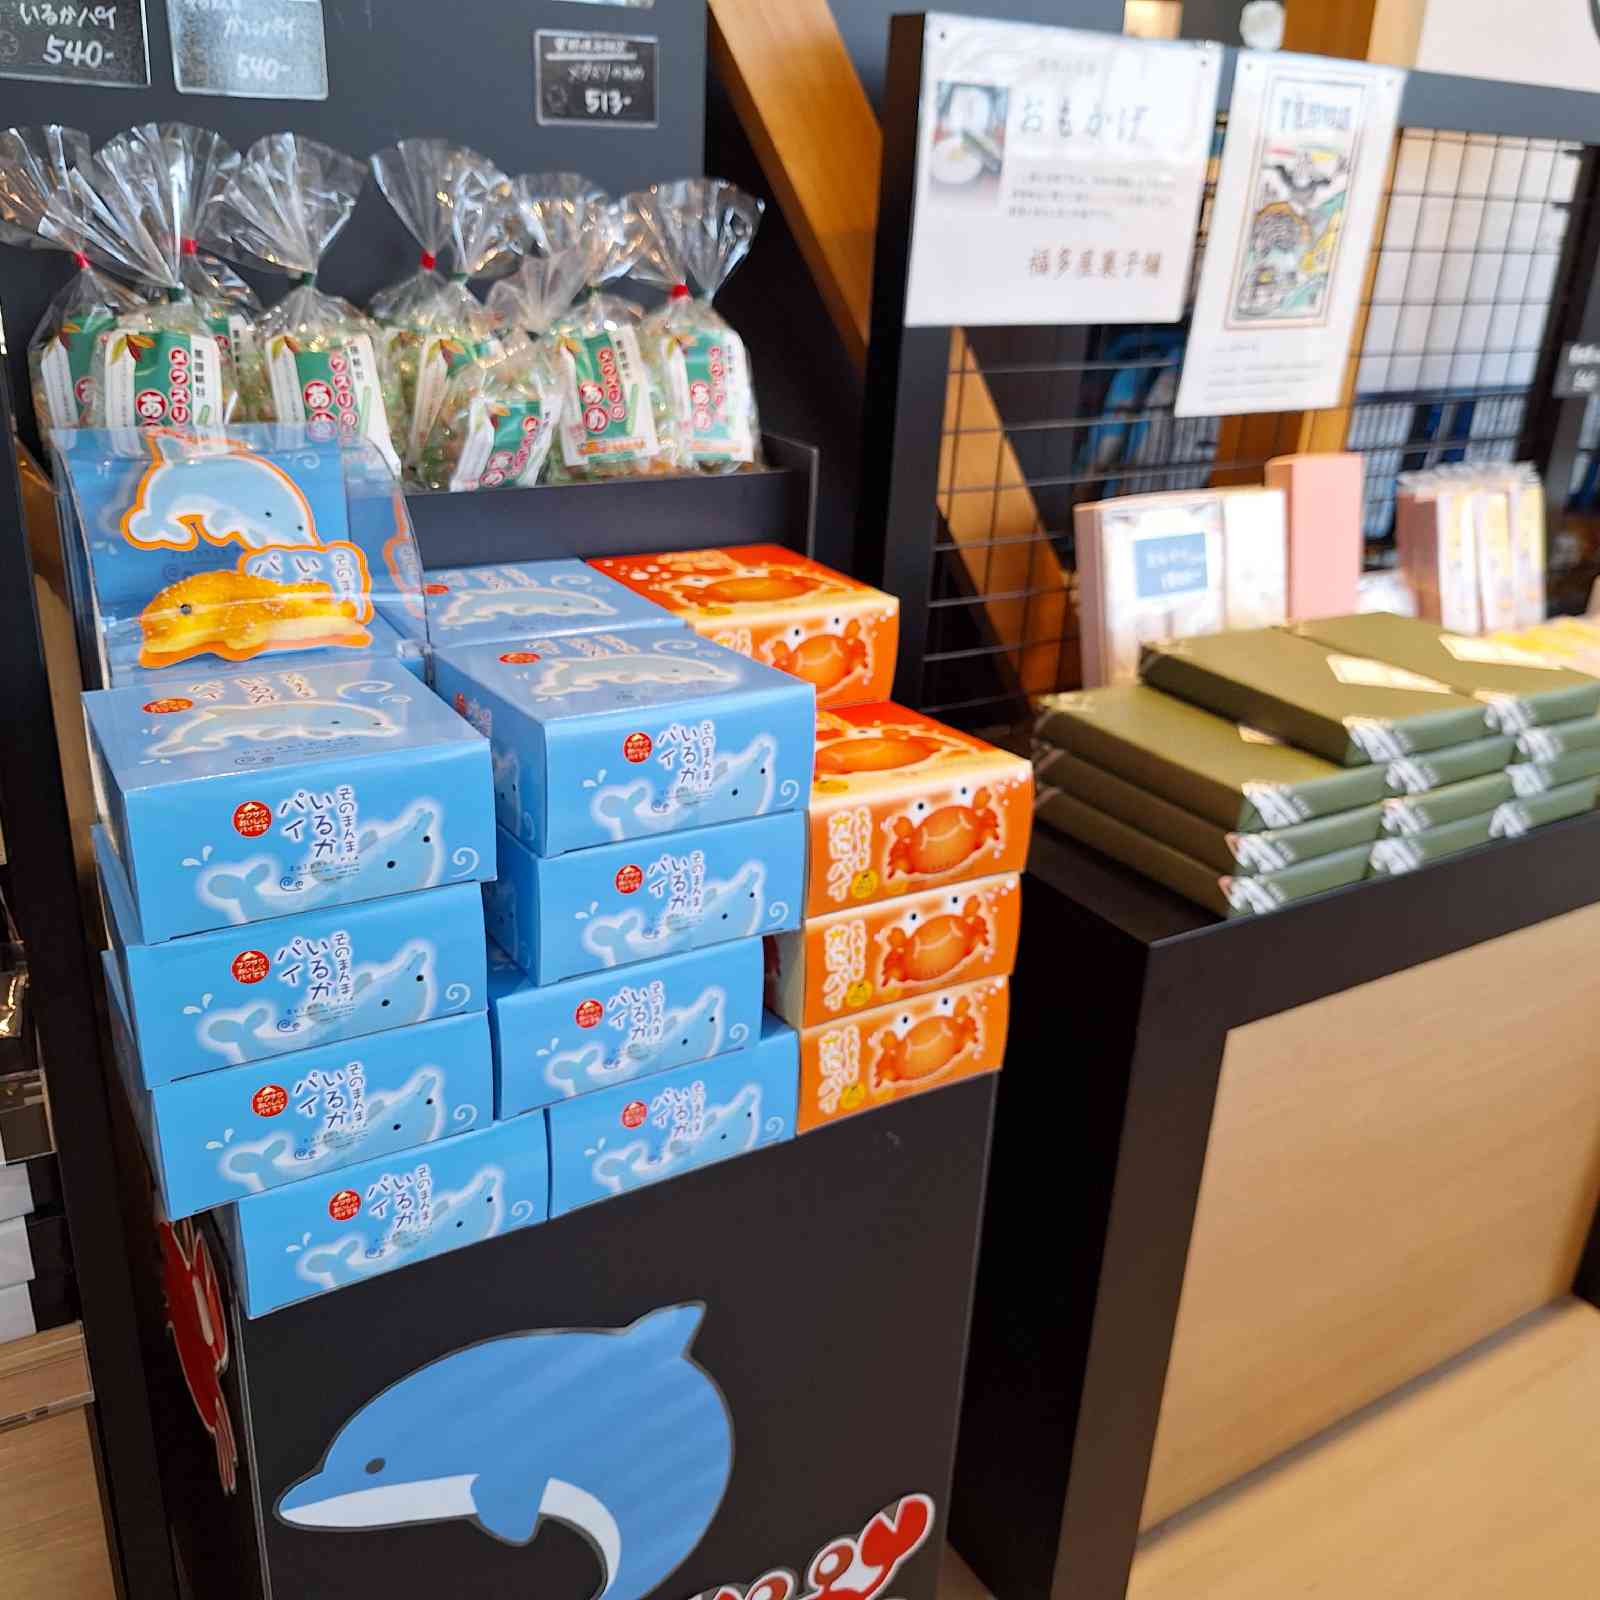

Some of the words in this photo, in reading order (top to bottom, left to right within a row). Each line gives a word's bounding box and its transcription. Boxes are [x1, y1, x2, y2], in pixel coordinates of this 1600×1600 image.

[19, 5, 117, 30] いるかパイ
[658, 725, 677, 767] パイ
[681, 727, 698, 785] いるか
[280, 792, 306, 840] パイ
[309, 794, 338, 858] いるか
[338, 786, 355, 854] そのまんま
[649, 856, 669, 897] パイ
[671, 858, 688, 911] いるか
[277, 938, 302, 984] パイ
[306, 941, 333, 1001] いるか
[335, 933, 351, 995] そのまんま
[608, 988, 629, 1028] パイ
[631, 988, 649, 1041] いるか
[295, 1071, 319, 1115] パイ
[322, 1071, 348, 1129] いるか
[350, 1063, 364, 1122] そのまんま
[367, 1175, 390, 1217] パイ
[393, 1174, 414, 1229] いるか
[417, 1166, 432, 1222] そのまんま
